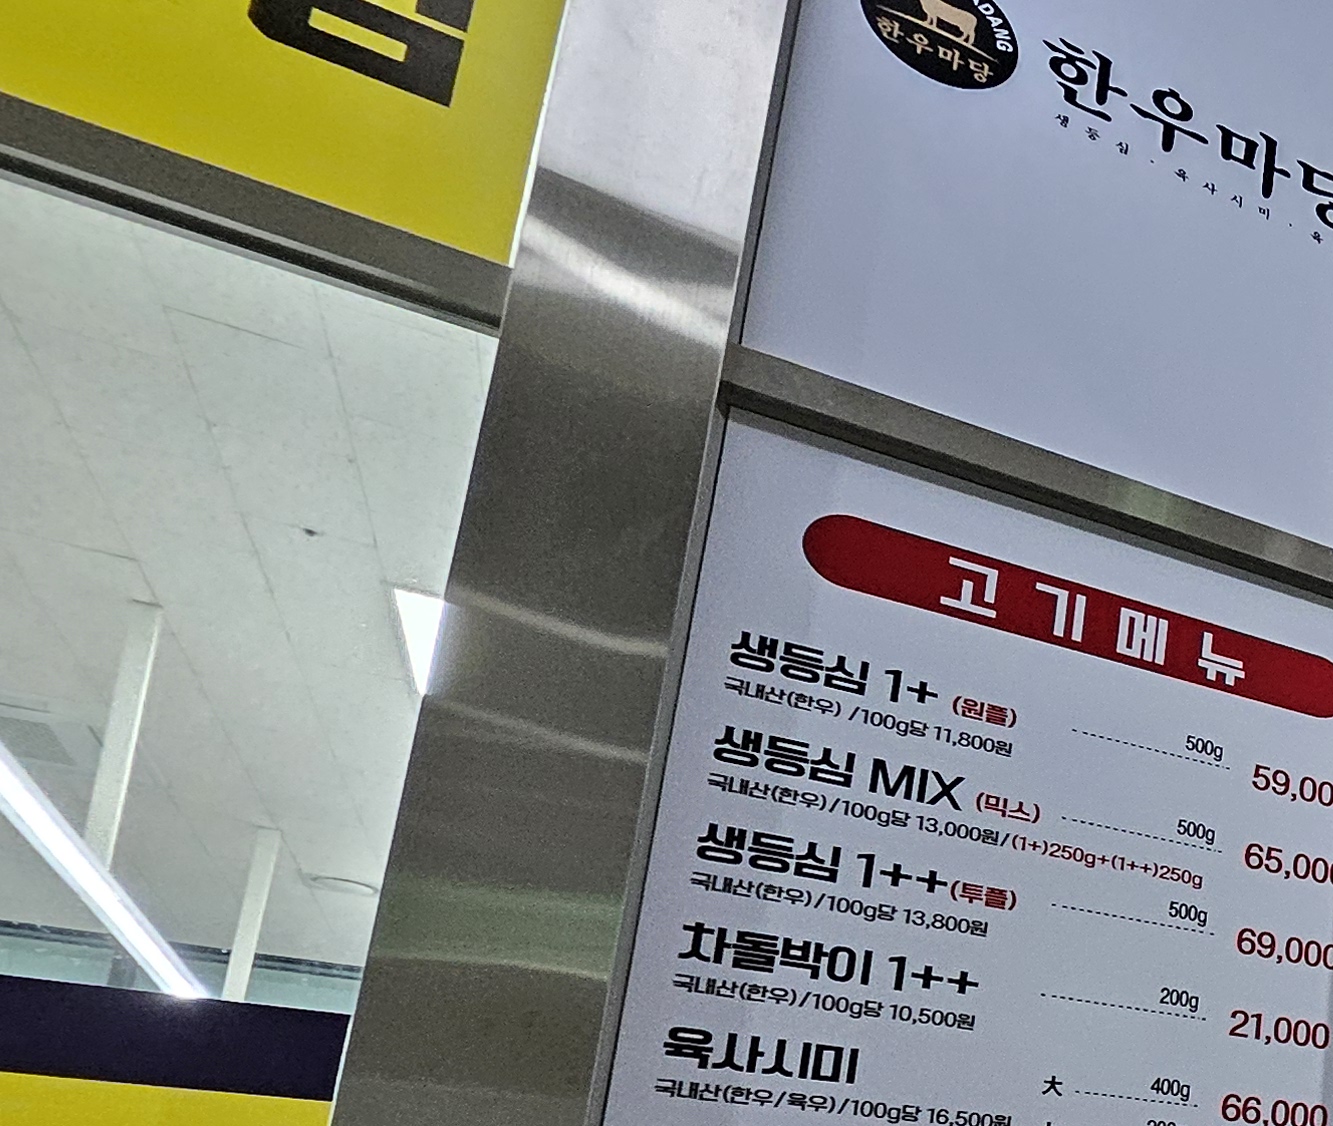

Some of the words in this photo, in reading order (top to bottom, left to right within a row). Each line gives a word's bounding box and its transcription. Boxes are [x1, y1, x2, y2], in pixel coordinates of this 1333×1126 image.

[876, 16, 994, 83] 한우마당
[974, 0, 1013, 52] DANG
[940, 555, 1245, 687] 고기메뉴
[724, 676, 842, 717] 국내산(한우)
[932, 725, 1013, 757] 11,800원
[729, 631, 870, 696] 생등심
[885, 669, 938, 704] 1+
[952, 696, 1018, 729] (원플)
[1185, 735, 1224, 762] 500g
[713, 725, 857, 788] 생등심
[868, 758, 966, 811] MIX
[975, 792, 1040, 824] (믹스)
[1176, 819, 1216, 845] 500g
[696, 822, 842, 884] 생등심
[1168, 900, 1208, 927] 500g
[902, 907, 989, 938] 13,800원
[677, 921, 874, 987] 차돌박이
[887, 955, 979, 996] 1++
[1159, 986, 1200, 1013] 200g
[1227, 1009, 1330, 1050] 21,000
[888, 1004, 977, 1032] 10,500원
[662, 1025, 860, 1085] 육사시미
[1041, 1075, 1063, 1098] 大
[1150, 1077, 1191, 1102] 400g
